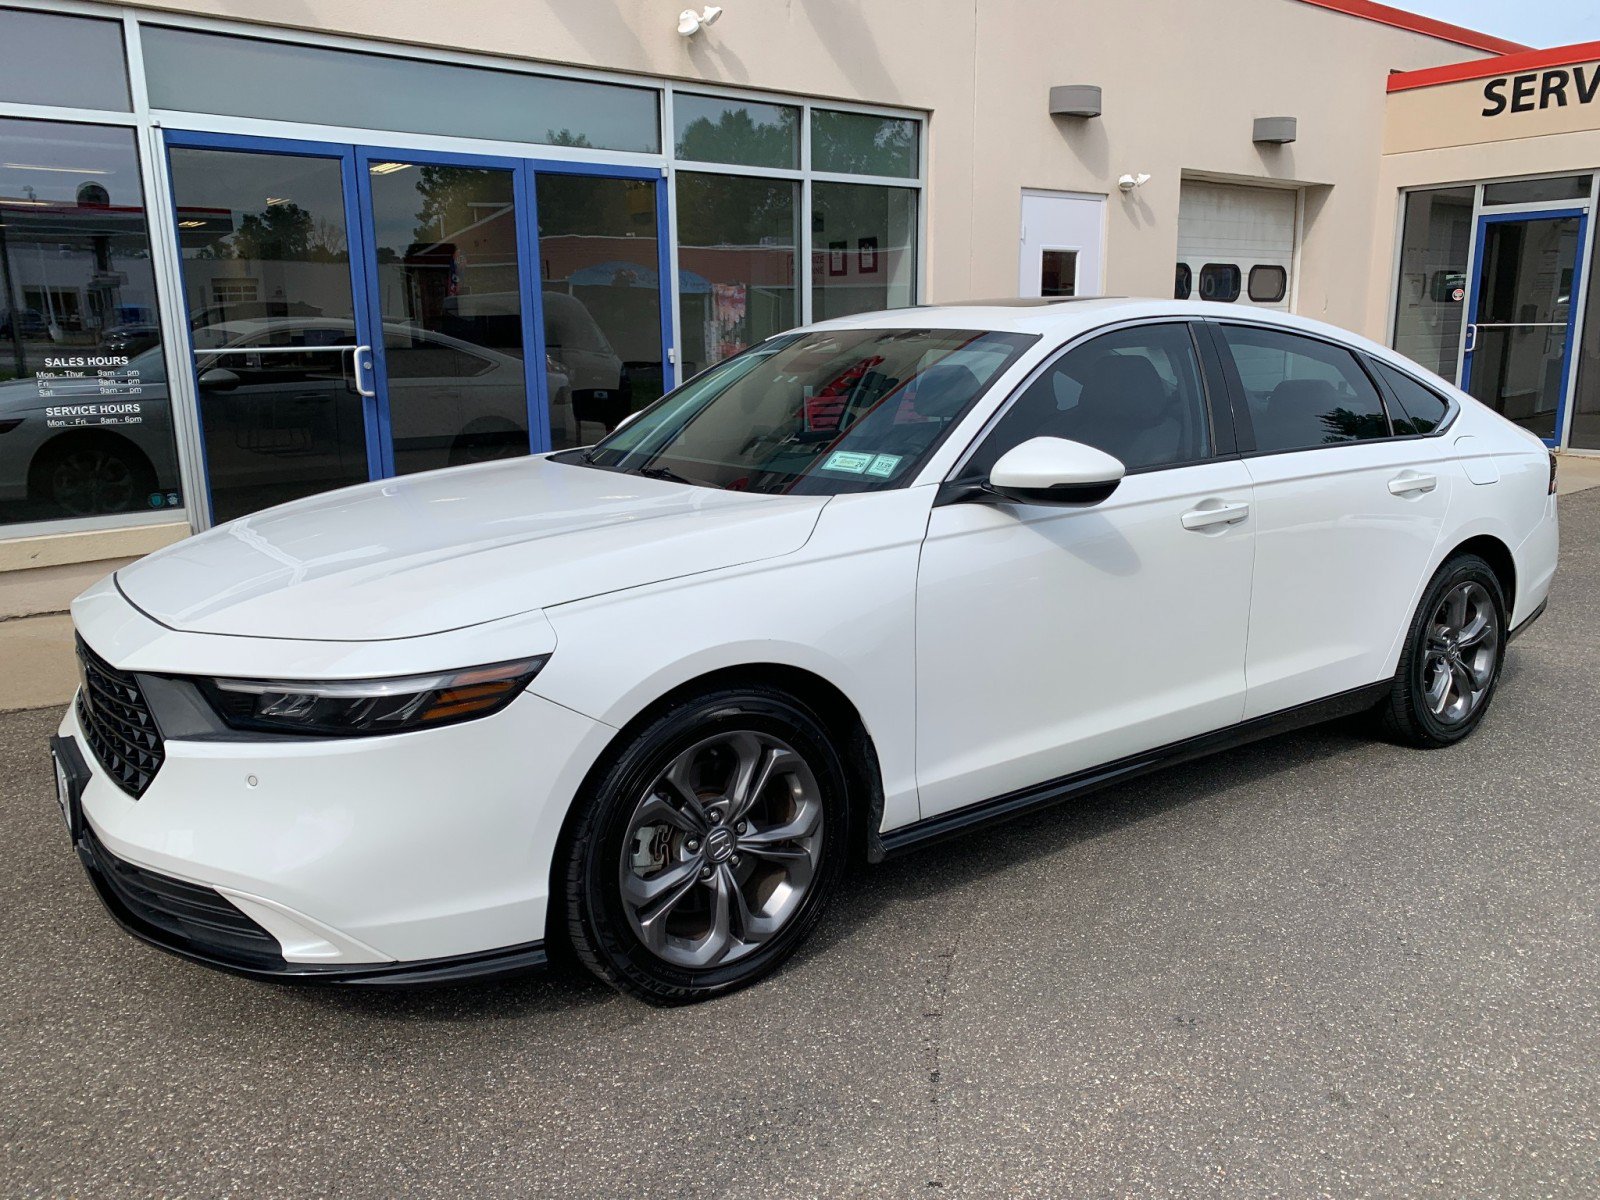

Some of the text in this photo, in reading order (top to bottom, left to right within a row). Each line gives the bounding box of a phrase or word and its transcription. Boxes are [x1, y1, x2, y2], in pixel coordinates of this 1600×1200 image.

[1482, 64, 1600, 117] SERV
[44, 356, 129, 368] SALES HOURS
[36, 371, 57, 379] Mon.
[64, 370, 86, 378] Thur.
[100, 387, 118, 395] 9am
[45, 403, 141, 417] SERVICE HOURS
[47, 419, 68, 428] Mon.
